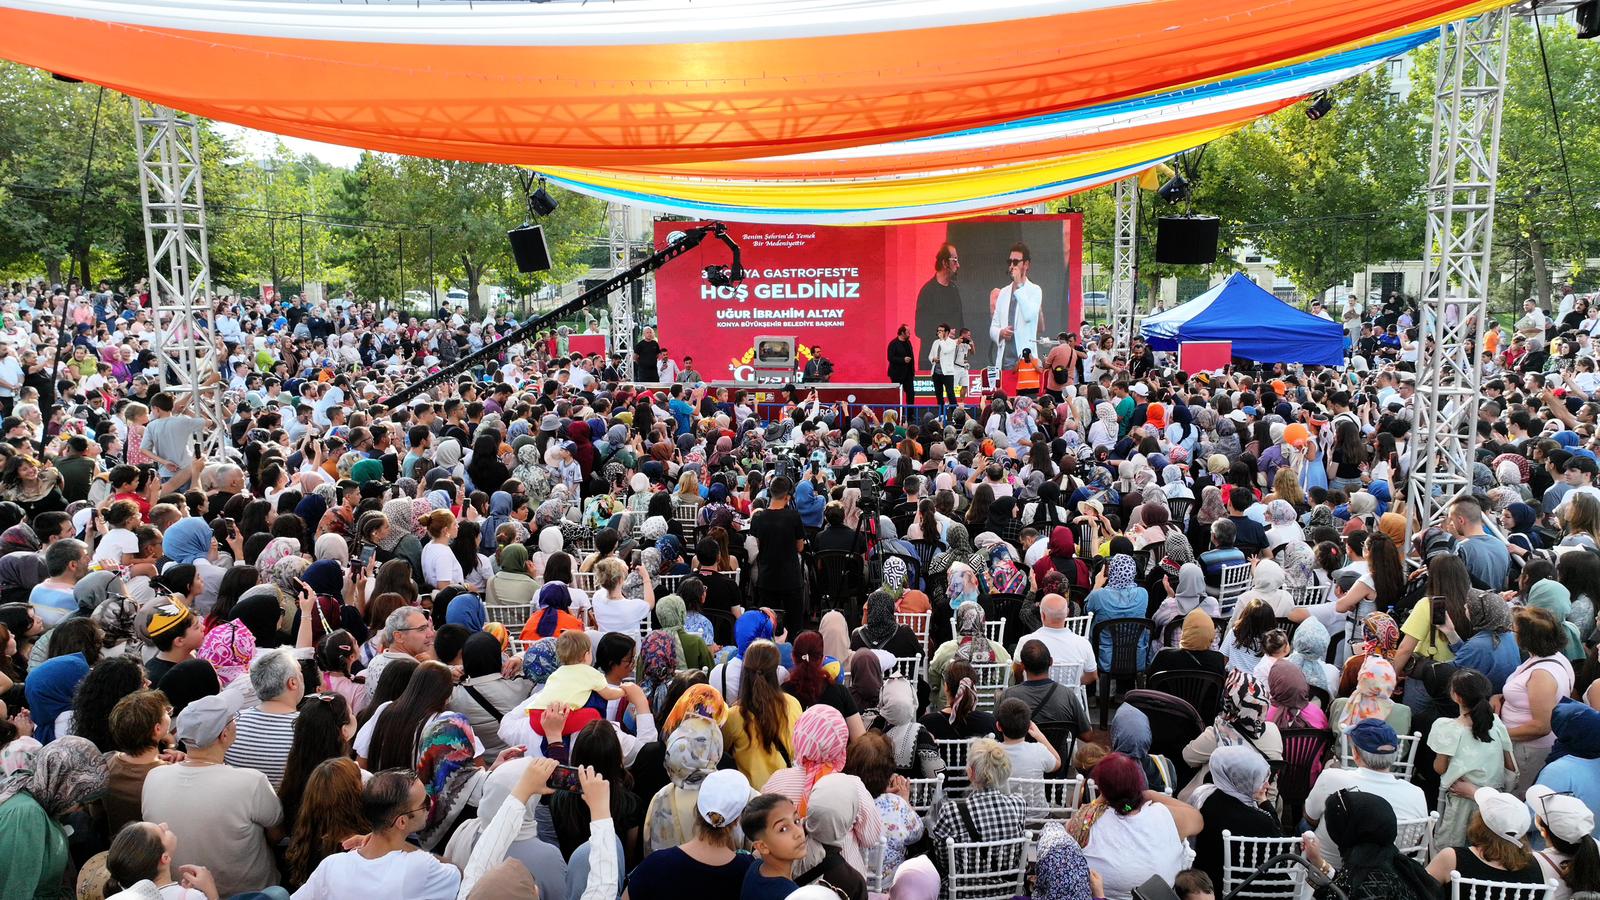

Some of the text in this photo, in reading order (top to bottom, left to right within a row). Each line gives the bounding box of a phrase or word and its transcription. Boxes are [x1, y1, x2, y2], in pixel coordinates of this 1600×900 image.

[763, 267, 859, 279] GASTROFEST'E
[701, 278, 860, 303] HOŞ GELDİNİZ
[716, 307, 845, 319] UĞUR İBRAHİM ALTAY
[740, 320, 782, 328] BÜYÜKŞEHİR
[782, 320, 815, 328] BELEDİYE
[815, 320, 845, 328] BAŞKANI
